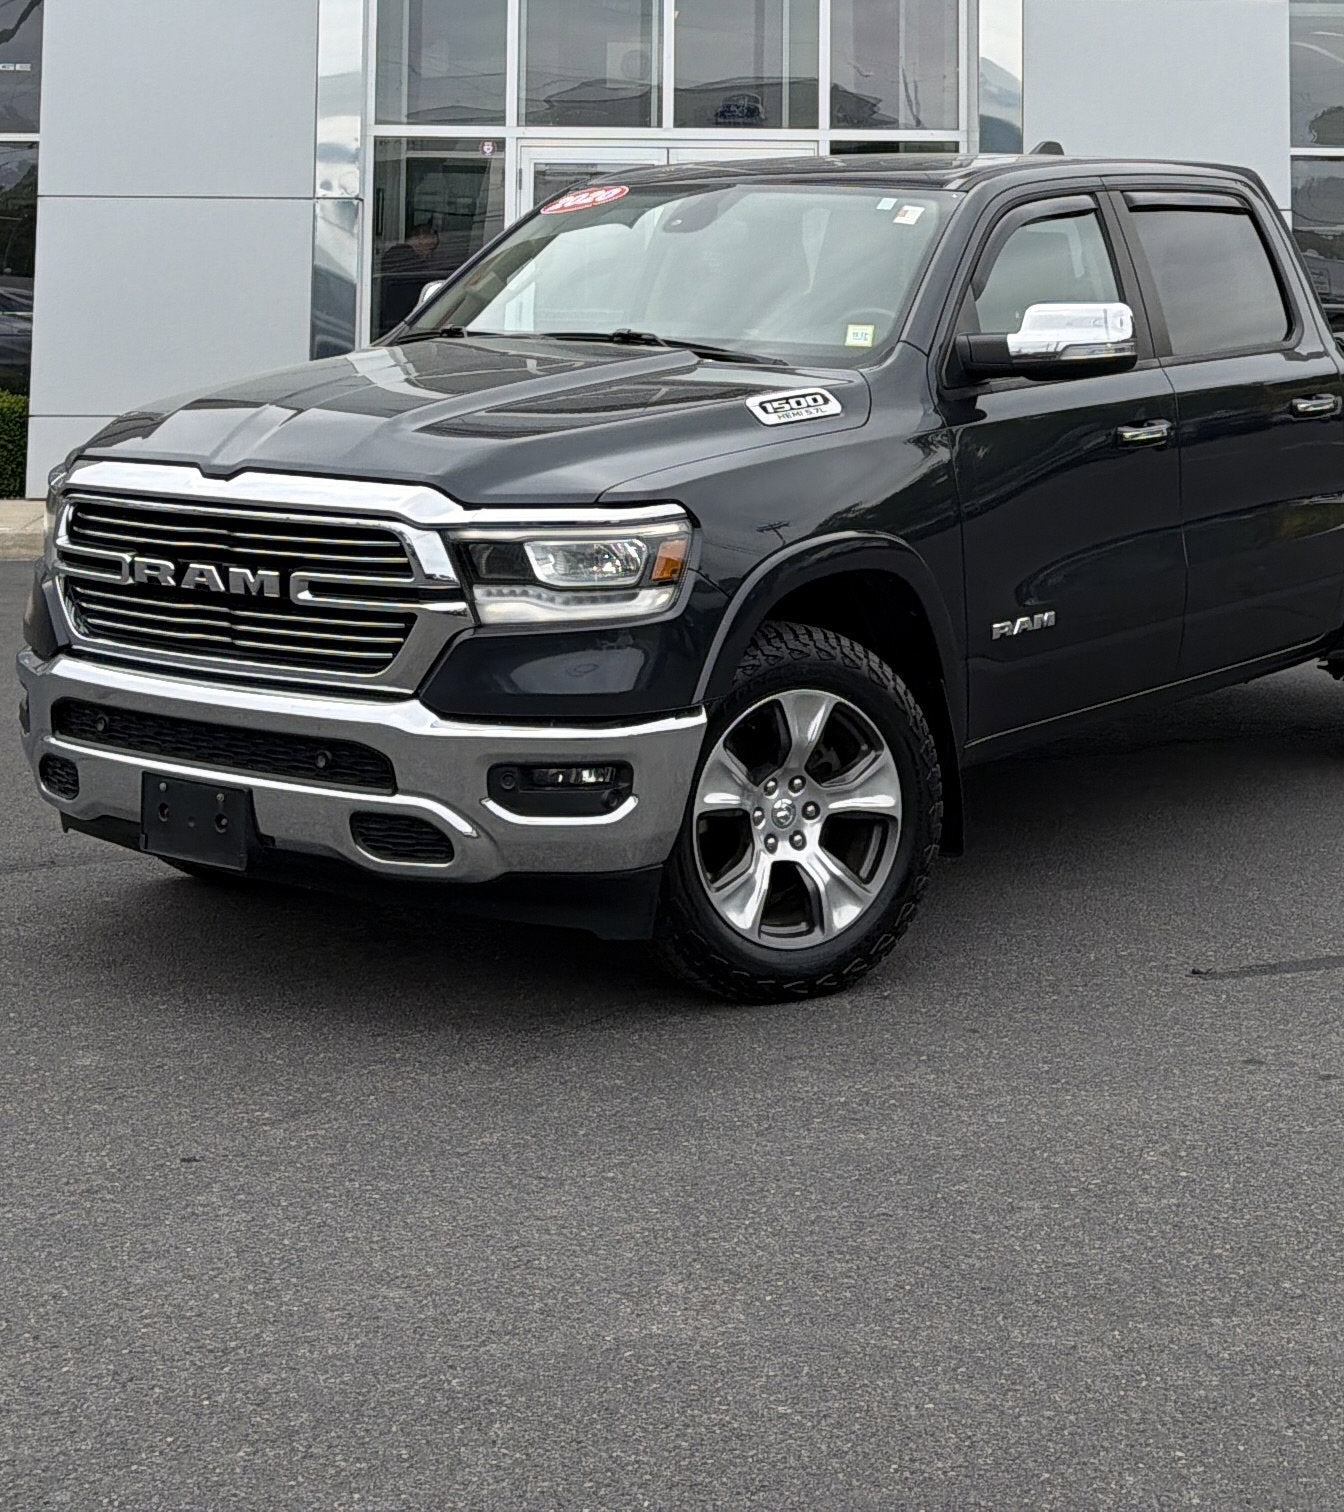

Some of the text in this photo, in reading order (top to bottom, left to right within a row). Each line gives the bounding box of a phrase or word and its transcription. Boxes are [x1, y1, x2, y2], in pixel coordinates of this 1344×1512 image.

[544, 187, 623, 211] 2020
[761, 394, 825, 413] 1500
[777, 410, 804, 420] HEMI
[134, 556, 280, 598] RAM
[992, 610, 1055, 640] RAM
